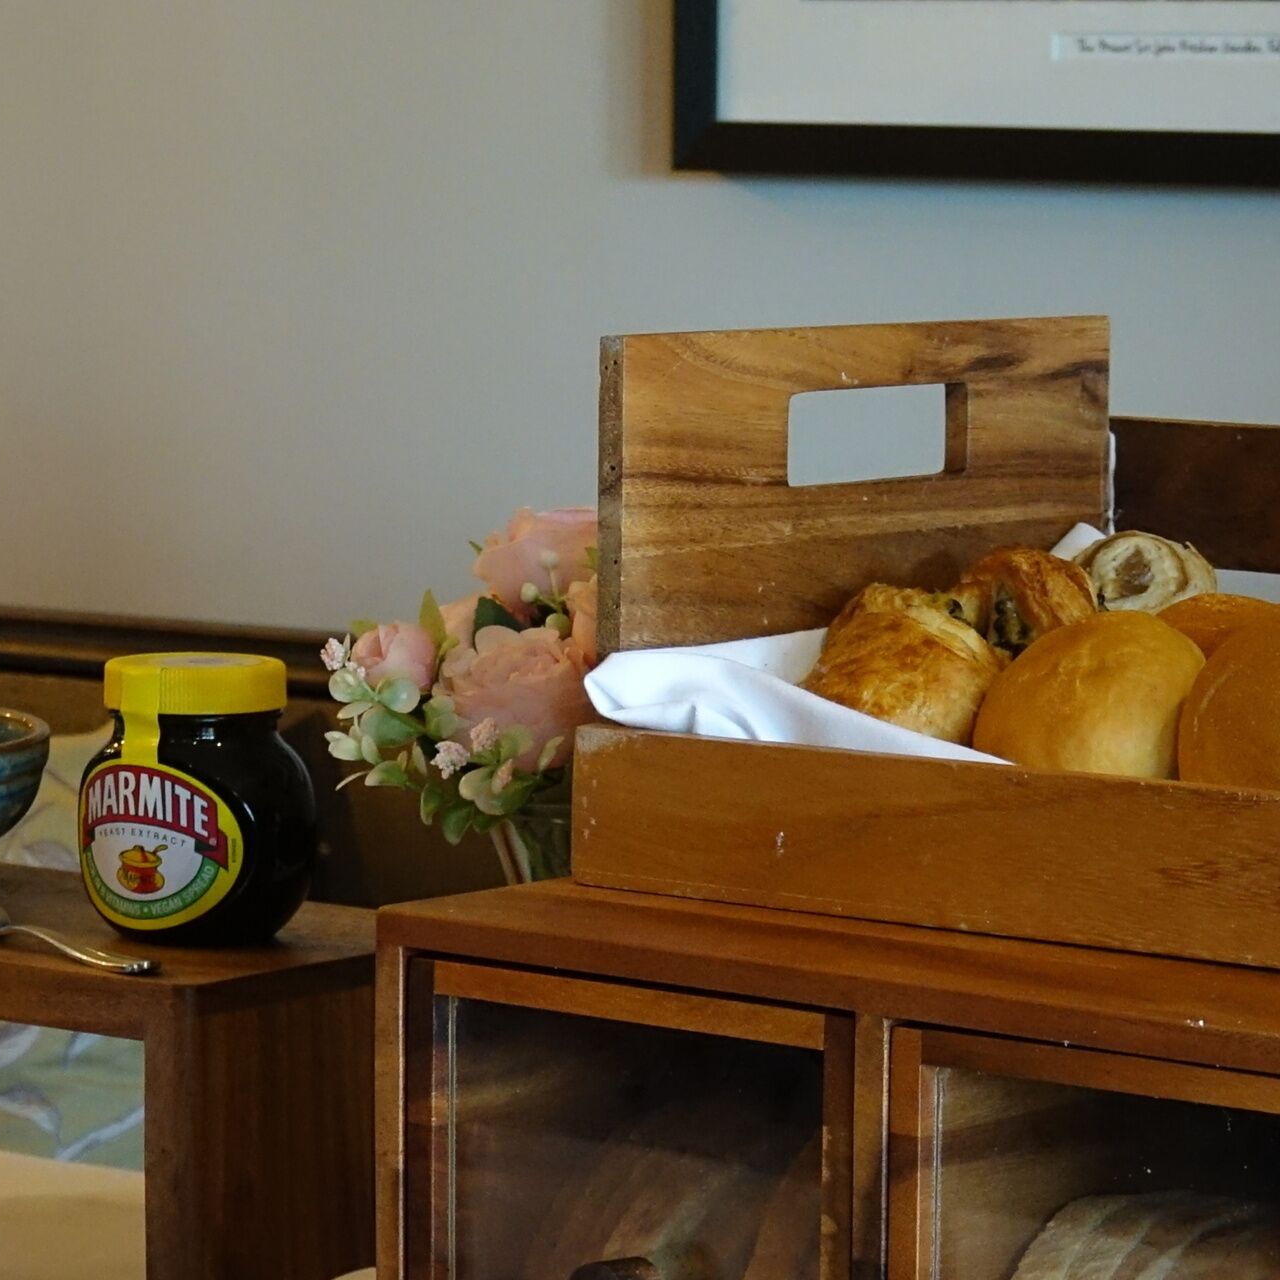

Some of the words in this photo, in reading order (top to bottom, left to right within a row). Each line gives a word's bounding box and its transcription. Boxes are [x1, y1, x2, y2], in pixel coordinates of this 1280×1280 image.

[88, 771, 208, 837] MARMITE
[99, 827, 125, 838] YEAST
[131, 828, 186, 848] EXTRACT
[182, 865, 215, 900] SPREAD
